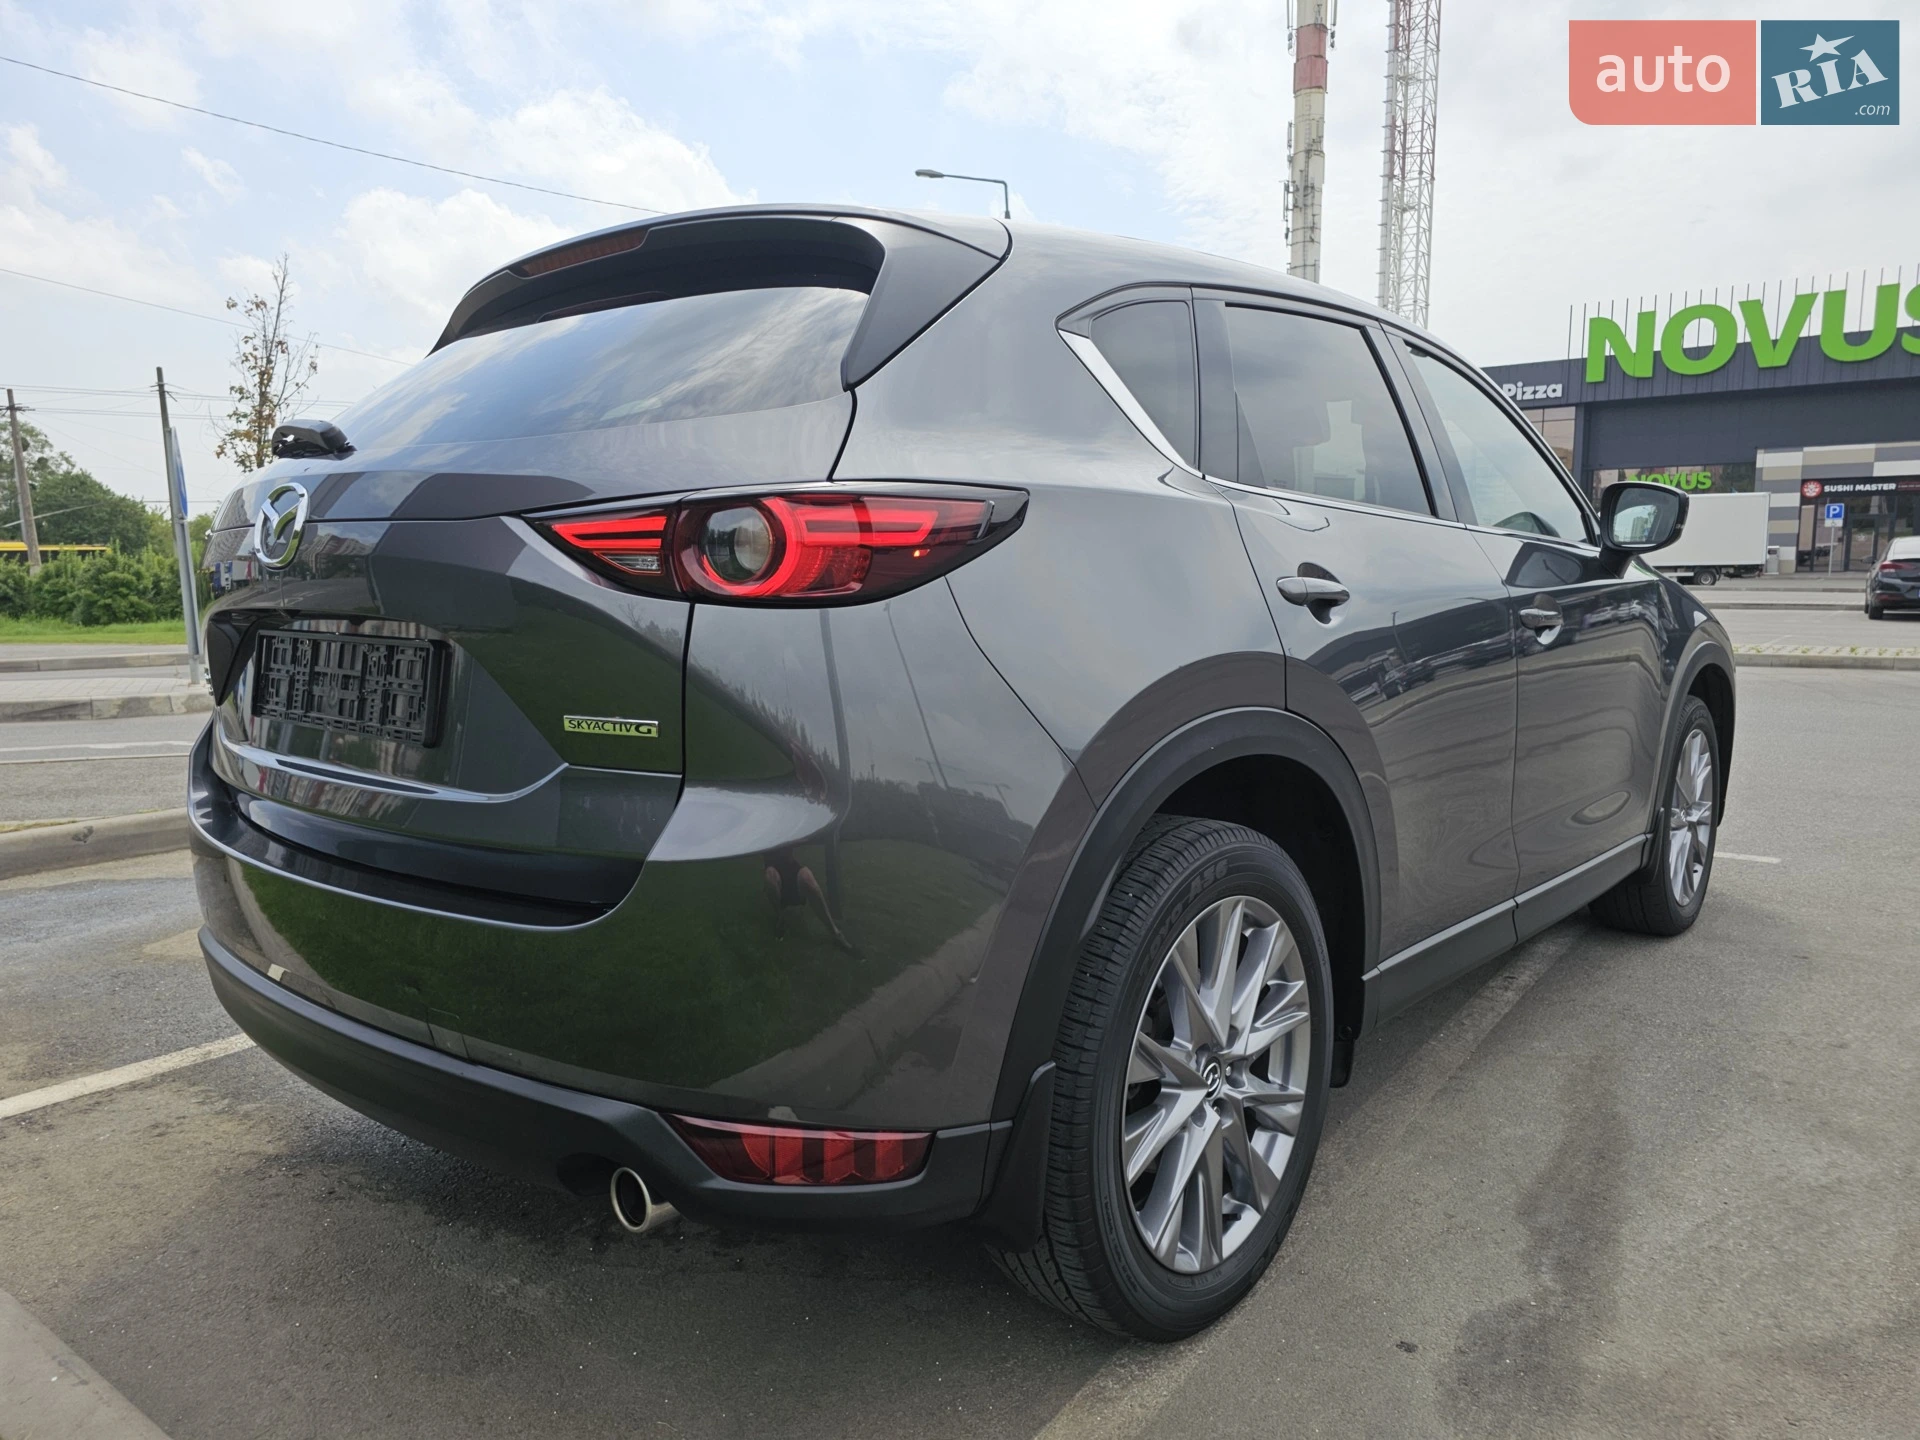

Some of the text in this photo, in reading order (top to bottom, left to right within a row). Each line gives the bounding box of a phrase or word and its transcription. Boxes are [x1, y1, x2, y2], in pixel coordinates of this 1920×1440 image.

[1502, 381, 1562, 400] Pizza
[1824, 484, 1853, 492] SUSHI
[1855, 483, 1896, 491] MASTER
[1829, 506, 1840, 518] P
